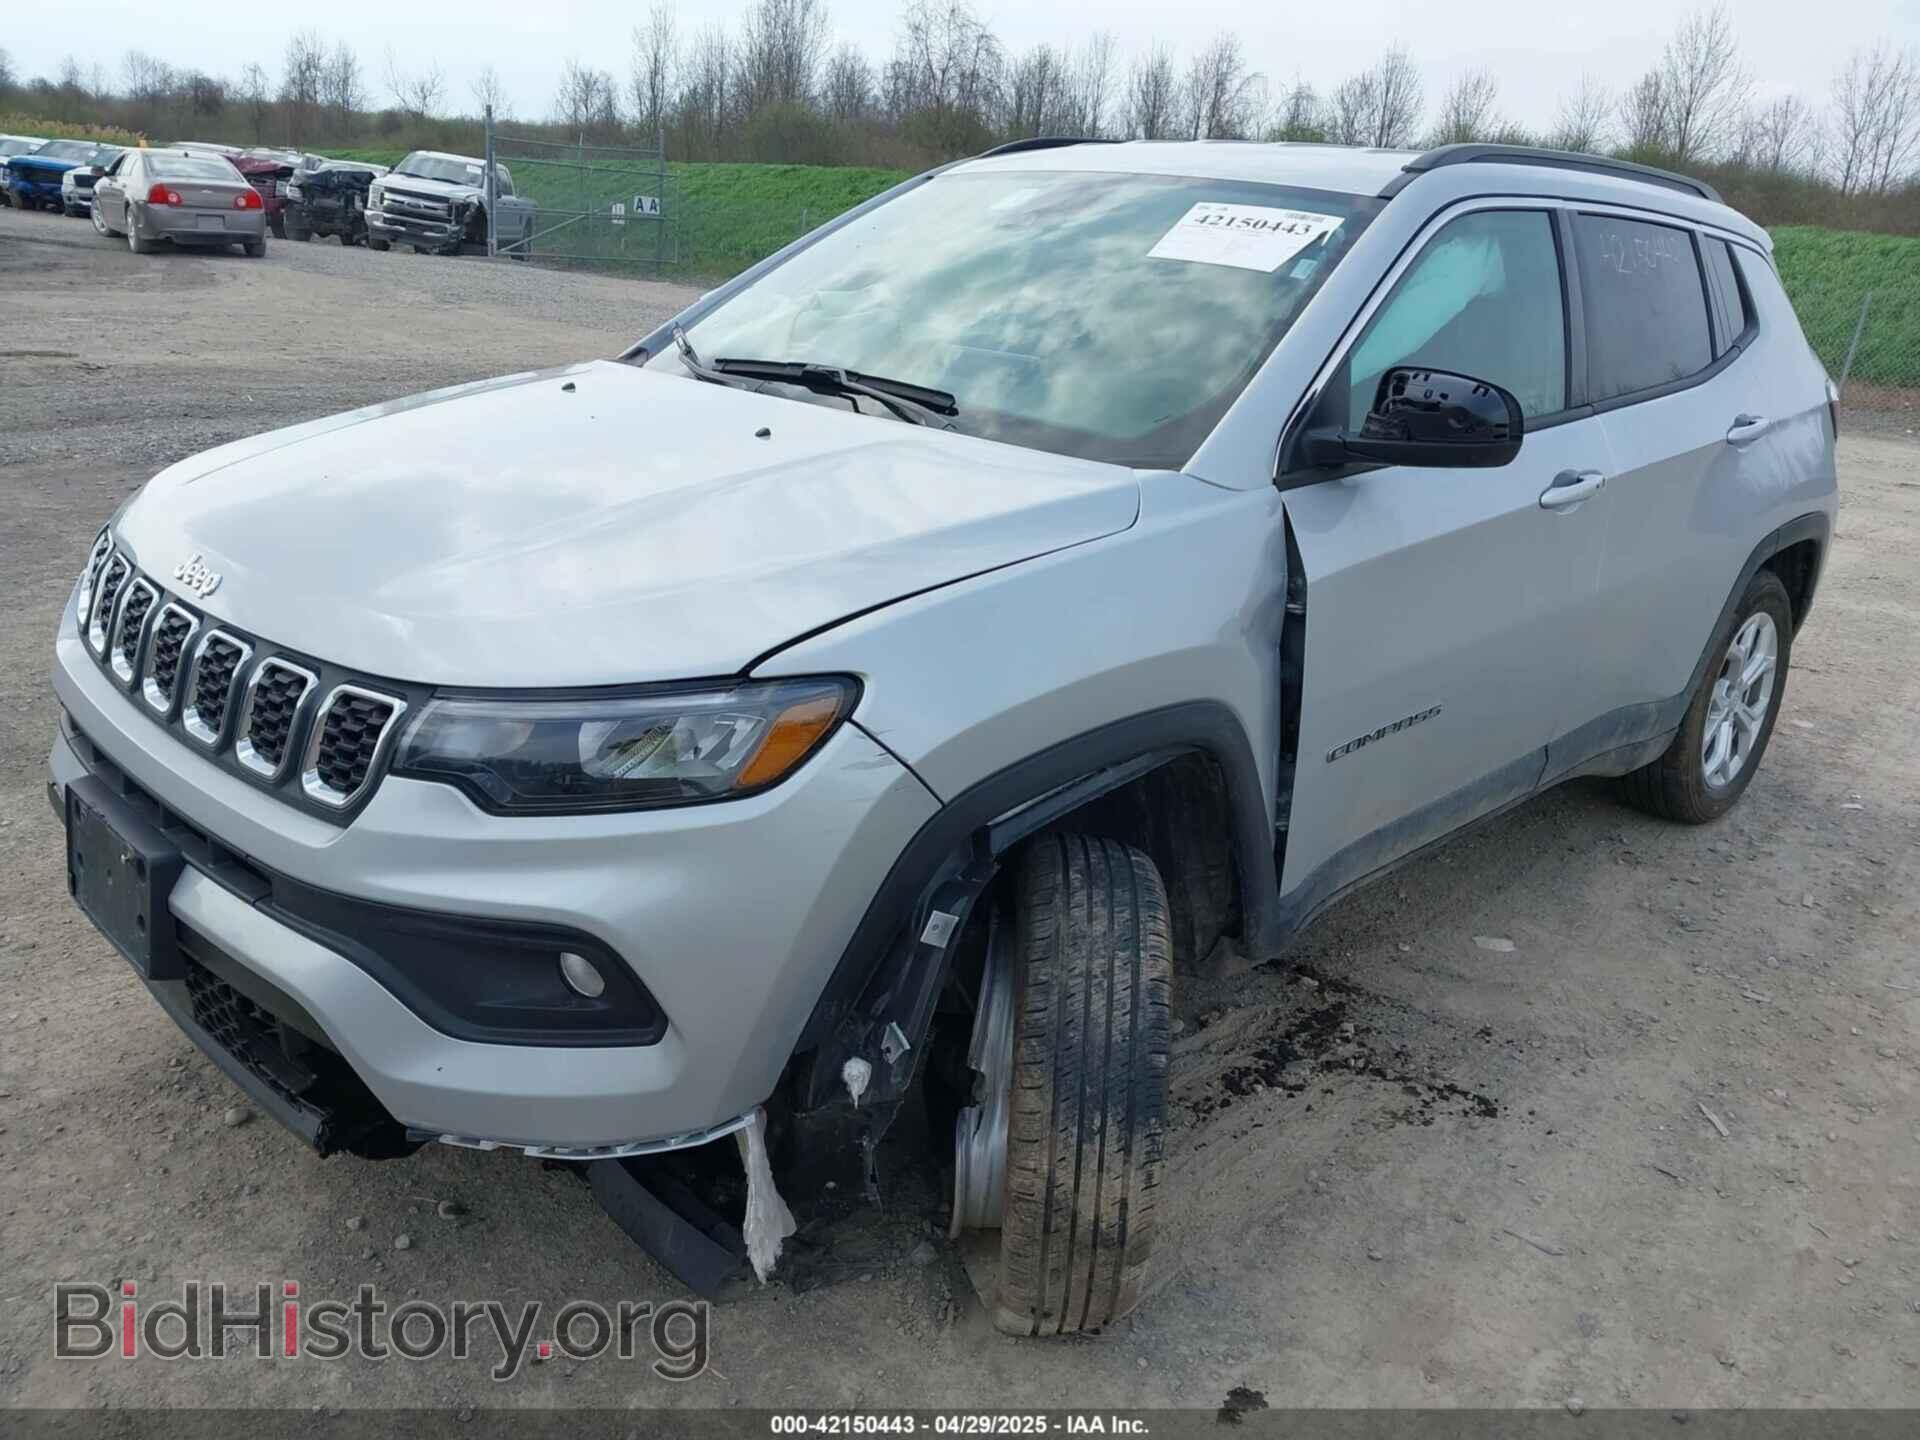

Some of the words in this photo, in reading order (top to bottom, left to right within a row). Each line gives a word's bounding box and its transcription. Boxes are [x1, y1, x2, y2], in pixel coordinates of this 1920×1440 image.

[1194, 214, 1312, 236] 42150443
[173, 553, 223, 600] Jeep
[1326, 704, 1442, 763] COMPASS
